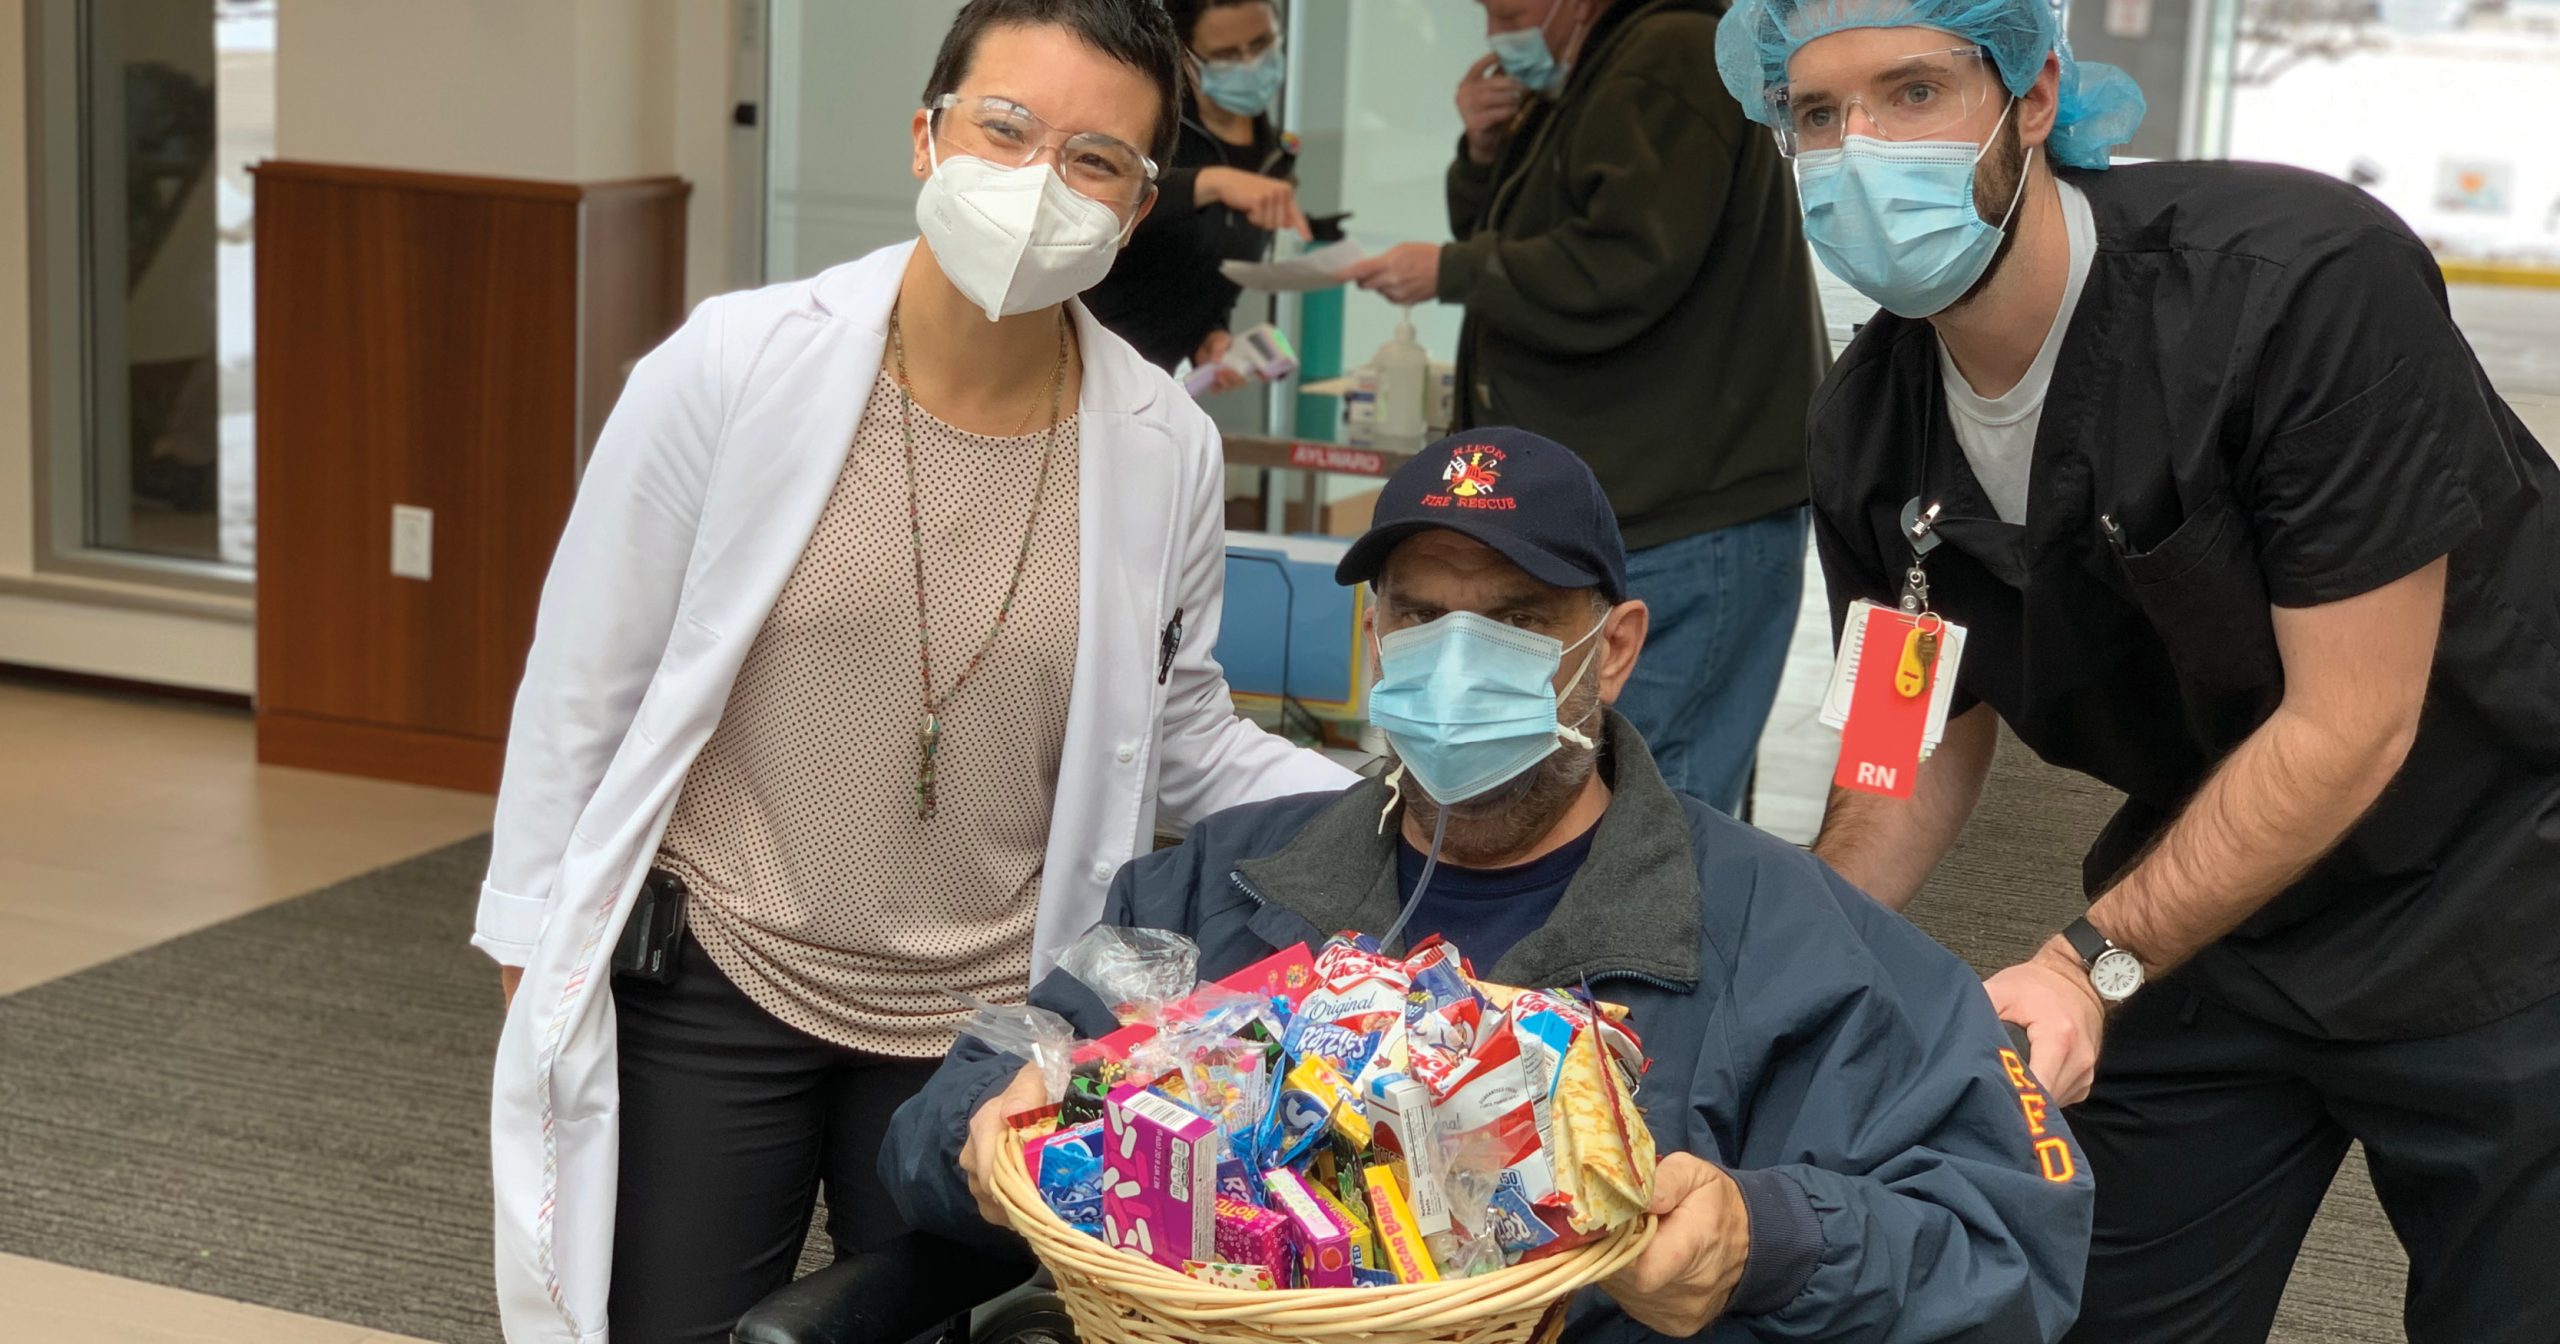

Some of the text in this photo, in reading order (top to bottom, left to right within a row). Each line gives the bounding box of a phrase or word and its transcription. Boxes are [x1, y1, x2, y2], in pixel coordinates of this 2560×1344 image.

[1451, 443, 1507, 461] RIPON
[1421, 494, 1517, 511] FIRE RESCUE
[1856, 761, 1897, 790] RN
[1309, 990, 1377, 1021] Original
[1998, 1048, 2075, 1183] RED
[1370, 1186, 1402, 1237] BABIES
[1392, 1237, 1424, 1283] SUGAR
